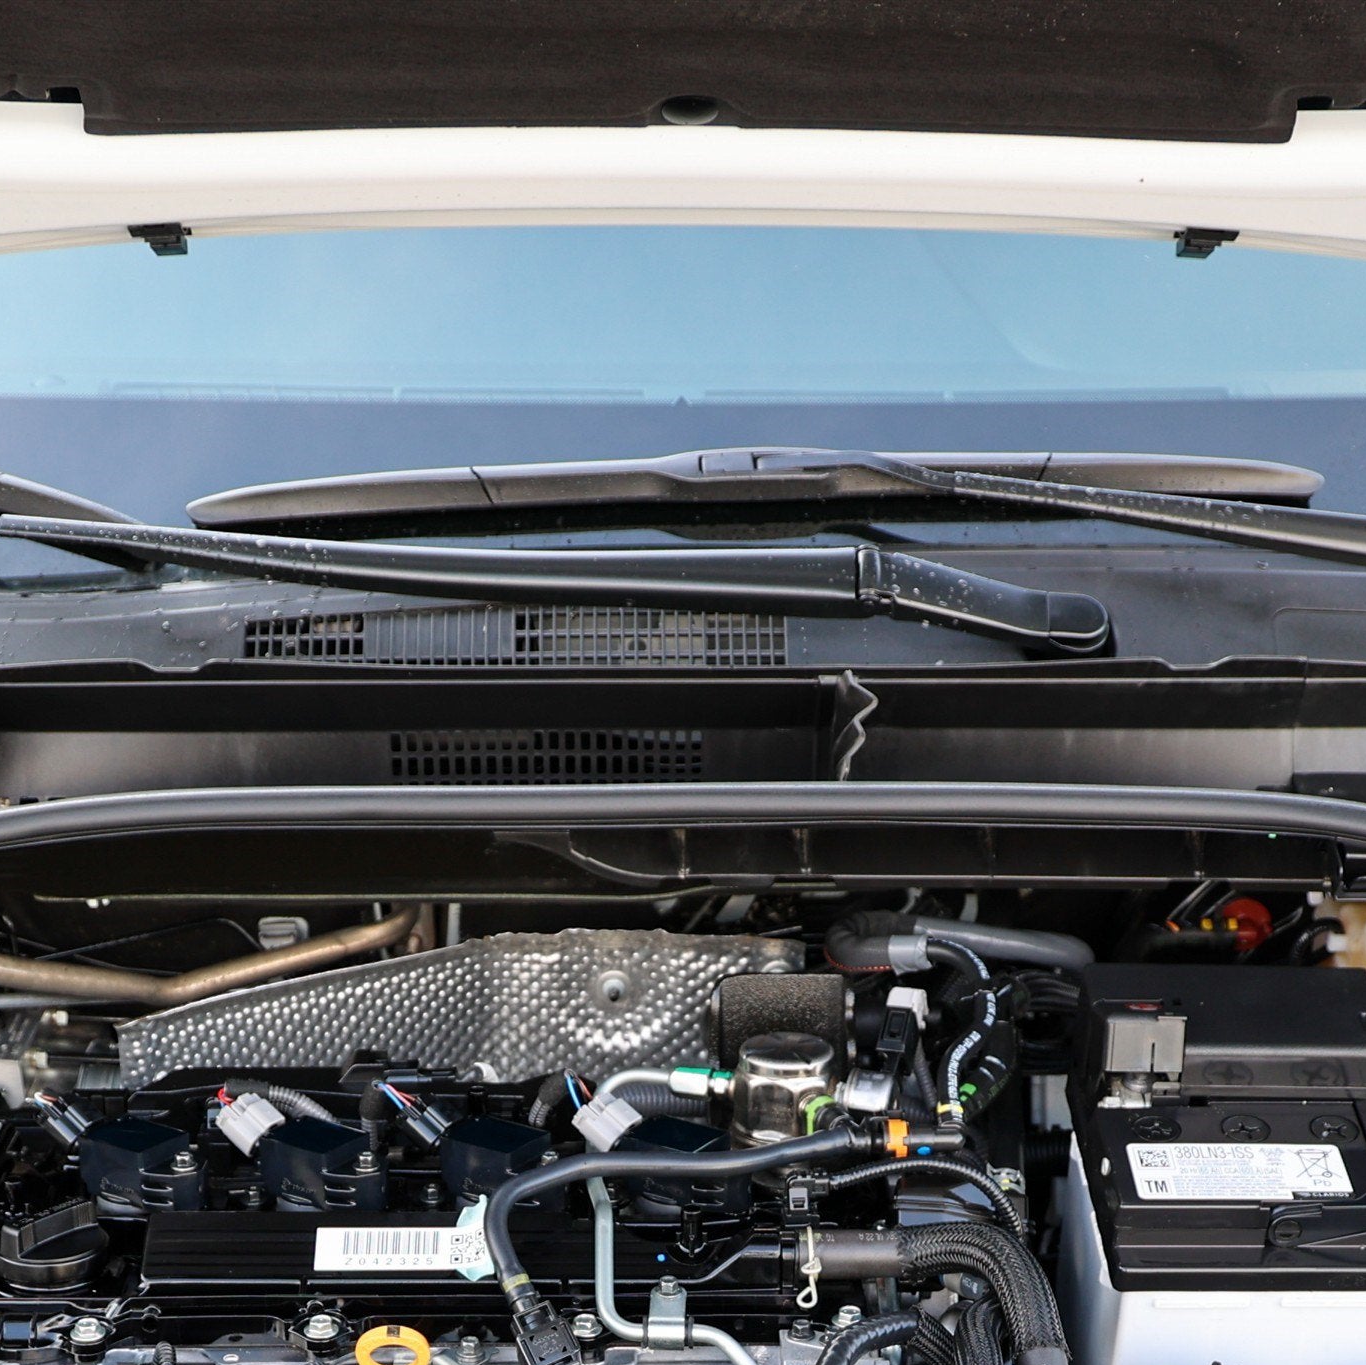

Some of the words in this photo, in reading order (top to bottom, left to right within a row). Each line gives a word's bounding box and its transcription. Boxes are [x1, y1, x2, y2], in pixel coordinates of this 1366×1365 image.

[1174, 1146, 1254, 1159] 380LN3-ISS
[1145, 1180, 1169, 1193] TM
[345, 1256, 434, 1267] Z042325
